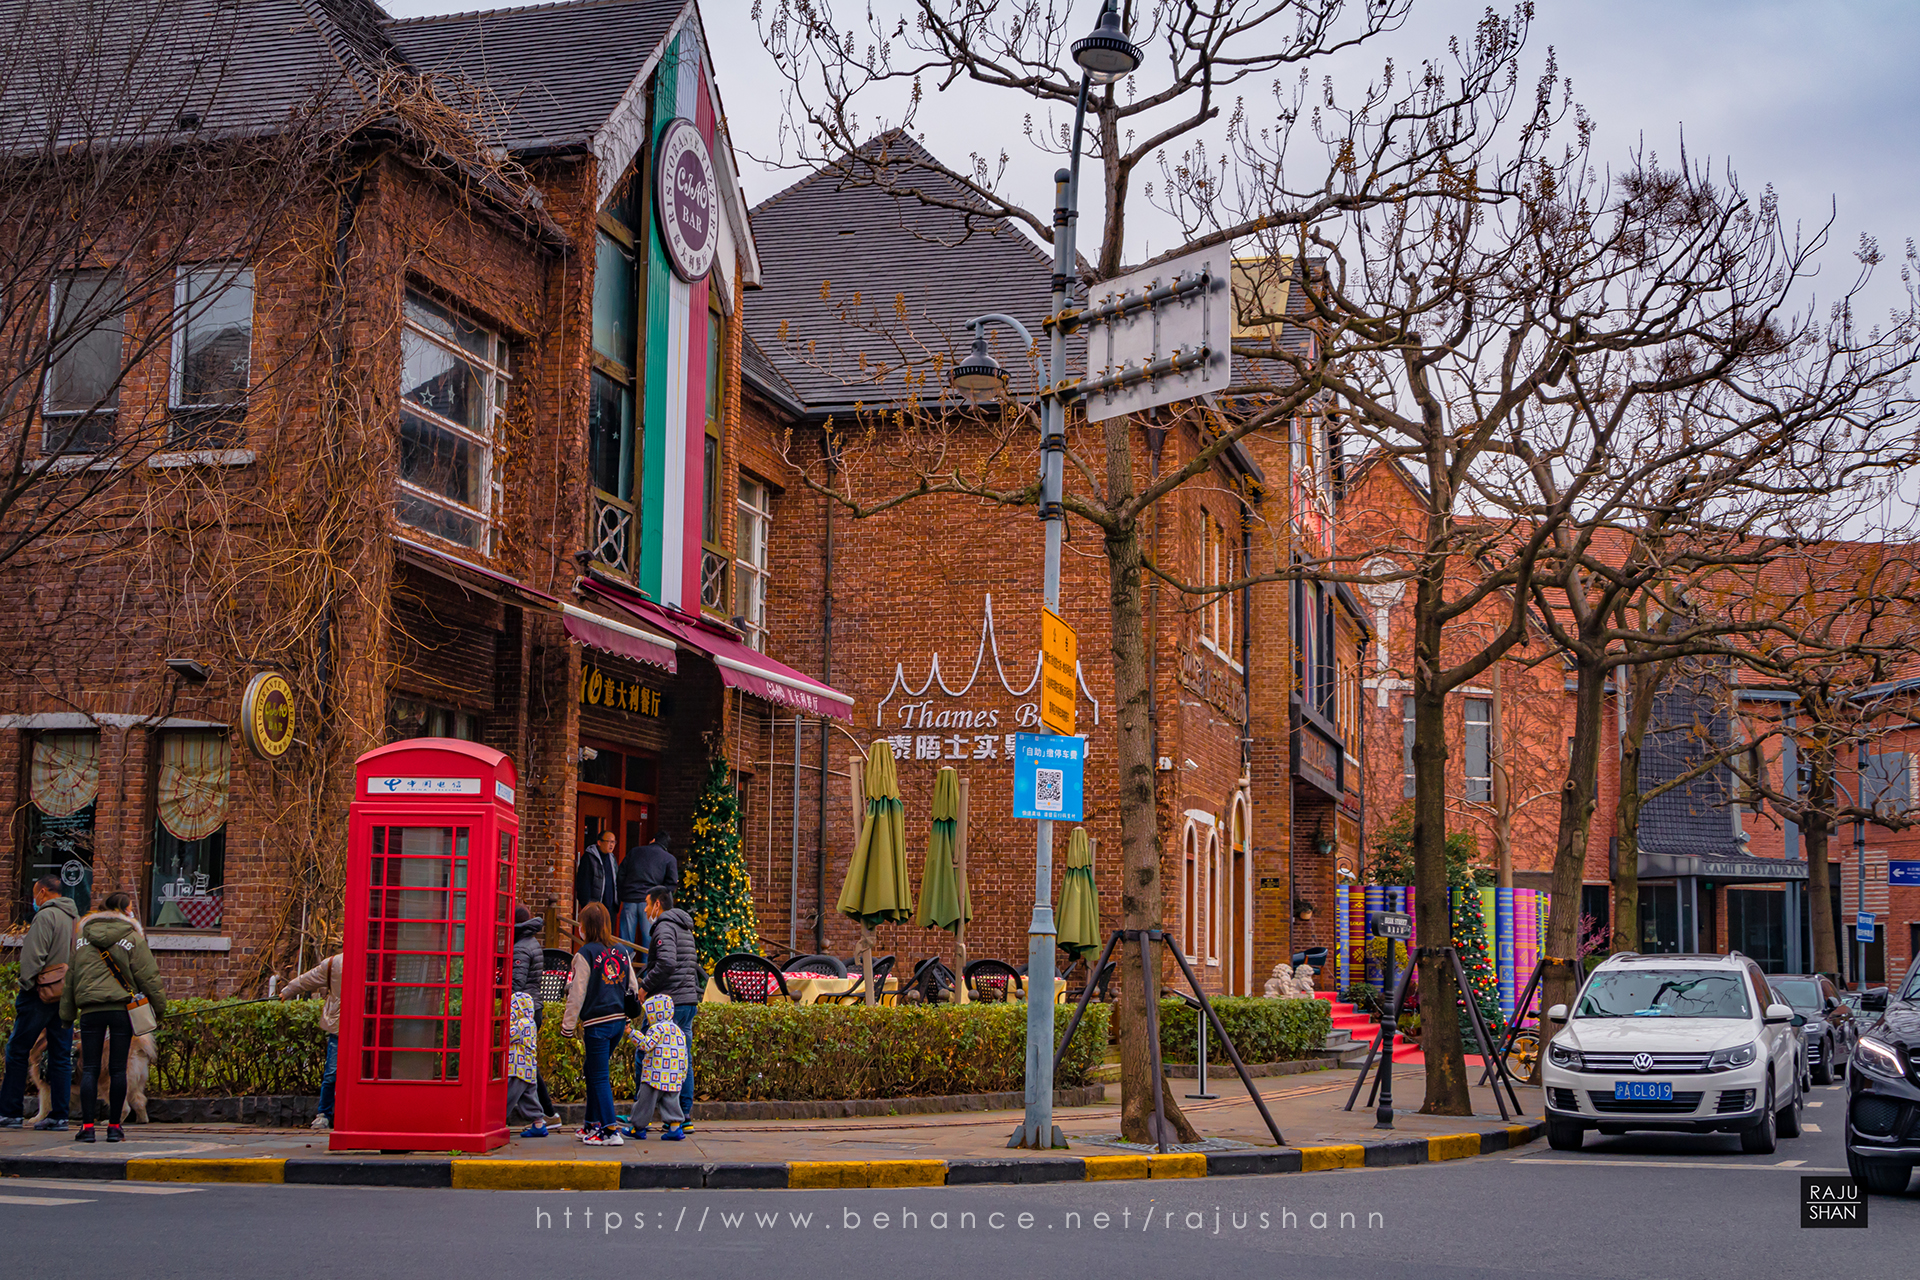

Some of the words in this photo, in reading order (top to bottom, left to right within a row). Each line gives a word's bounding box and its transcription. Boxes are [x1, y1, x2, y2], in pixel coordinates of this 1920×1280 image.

[665, 131, 700, 224] RISTORANTE
[677, 166, 708, 210] CIAO
[682, 204, 703, 234] BAR
[603, 677, 661, 717] 意大利餐厅
[268, 720, 283, 732] BAR
[898, 700, 999, 729] Thames
[406, 779, 461, 788] 中国电信
